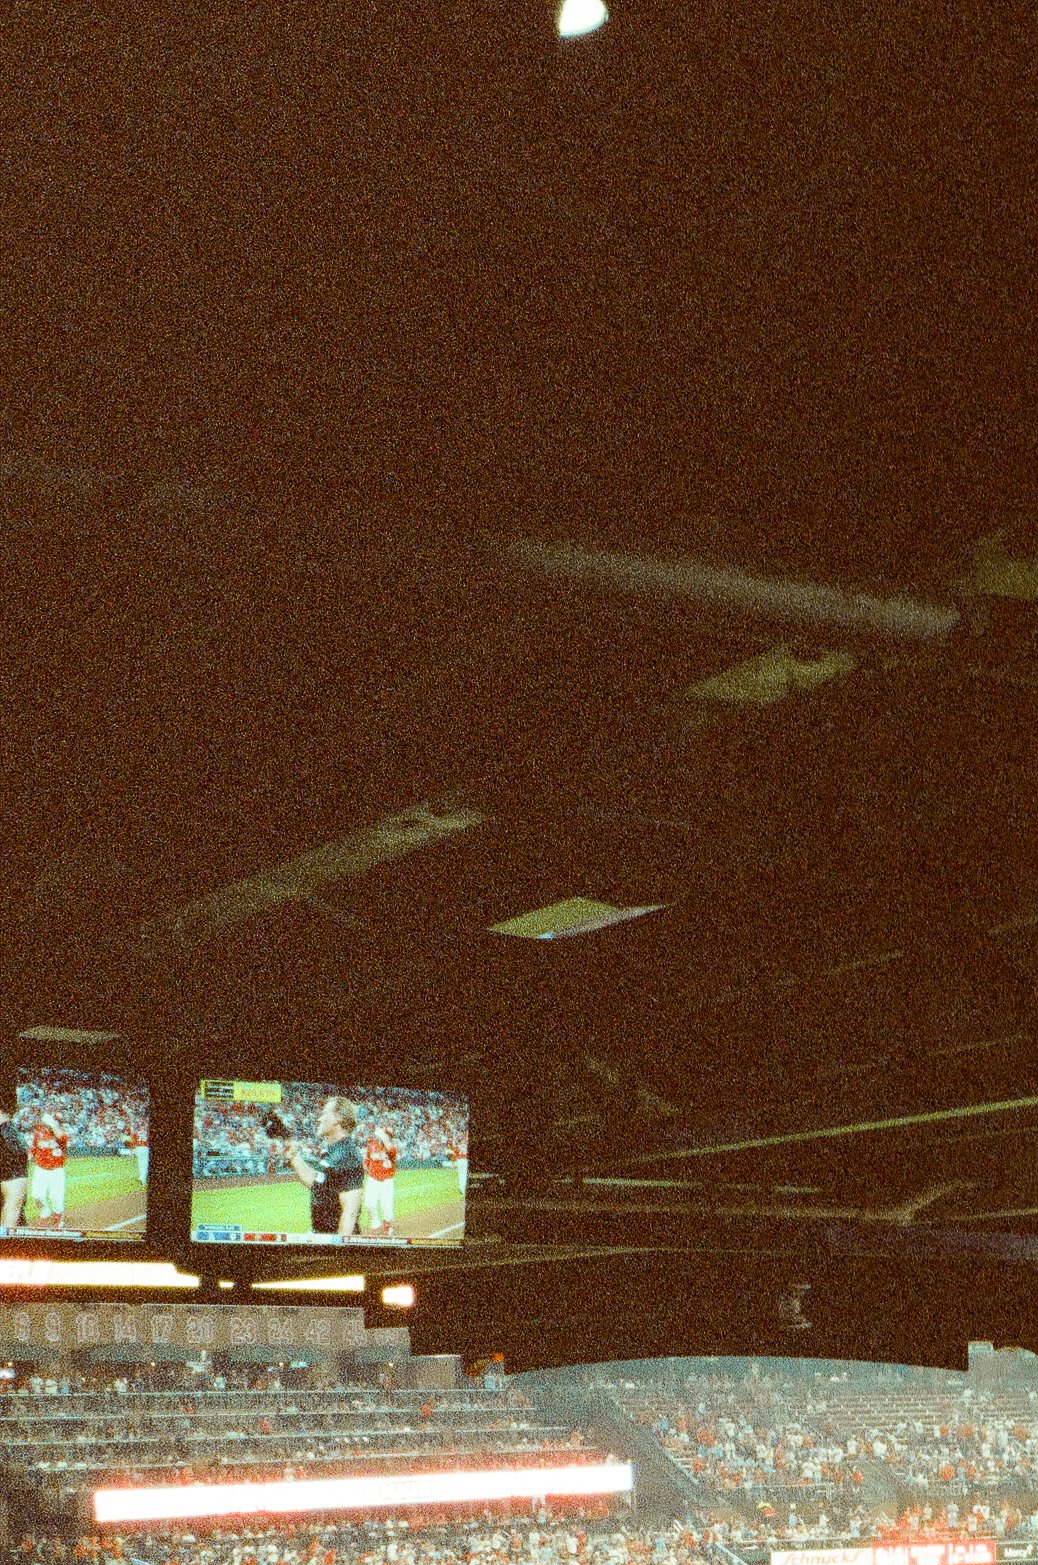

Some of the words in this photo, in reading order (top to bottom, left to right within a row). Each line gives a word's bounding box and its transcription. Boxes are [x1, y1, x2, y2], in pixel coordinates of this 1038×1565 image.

[113, 1315, 138, 1345] 14
[150, 1315, 174, 1344] 17
[304, 1318, 331, 1347] 42
